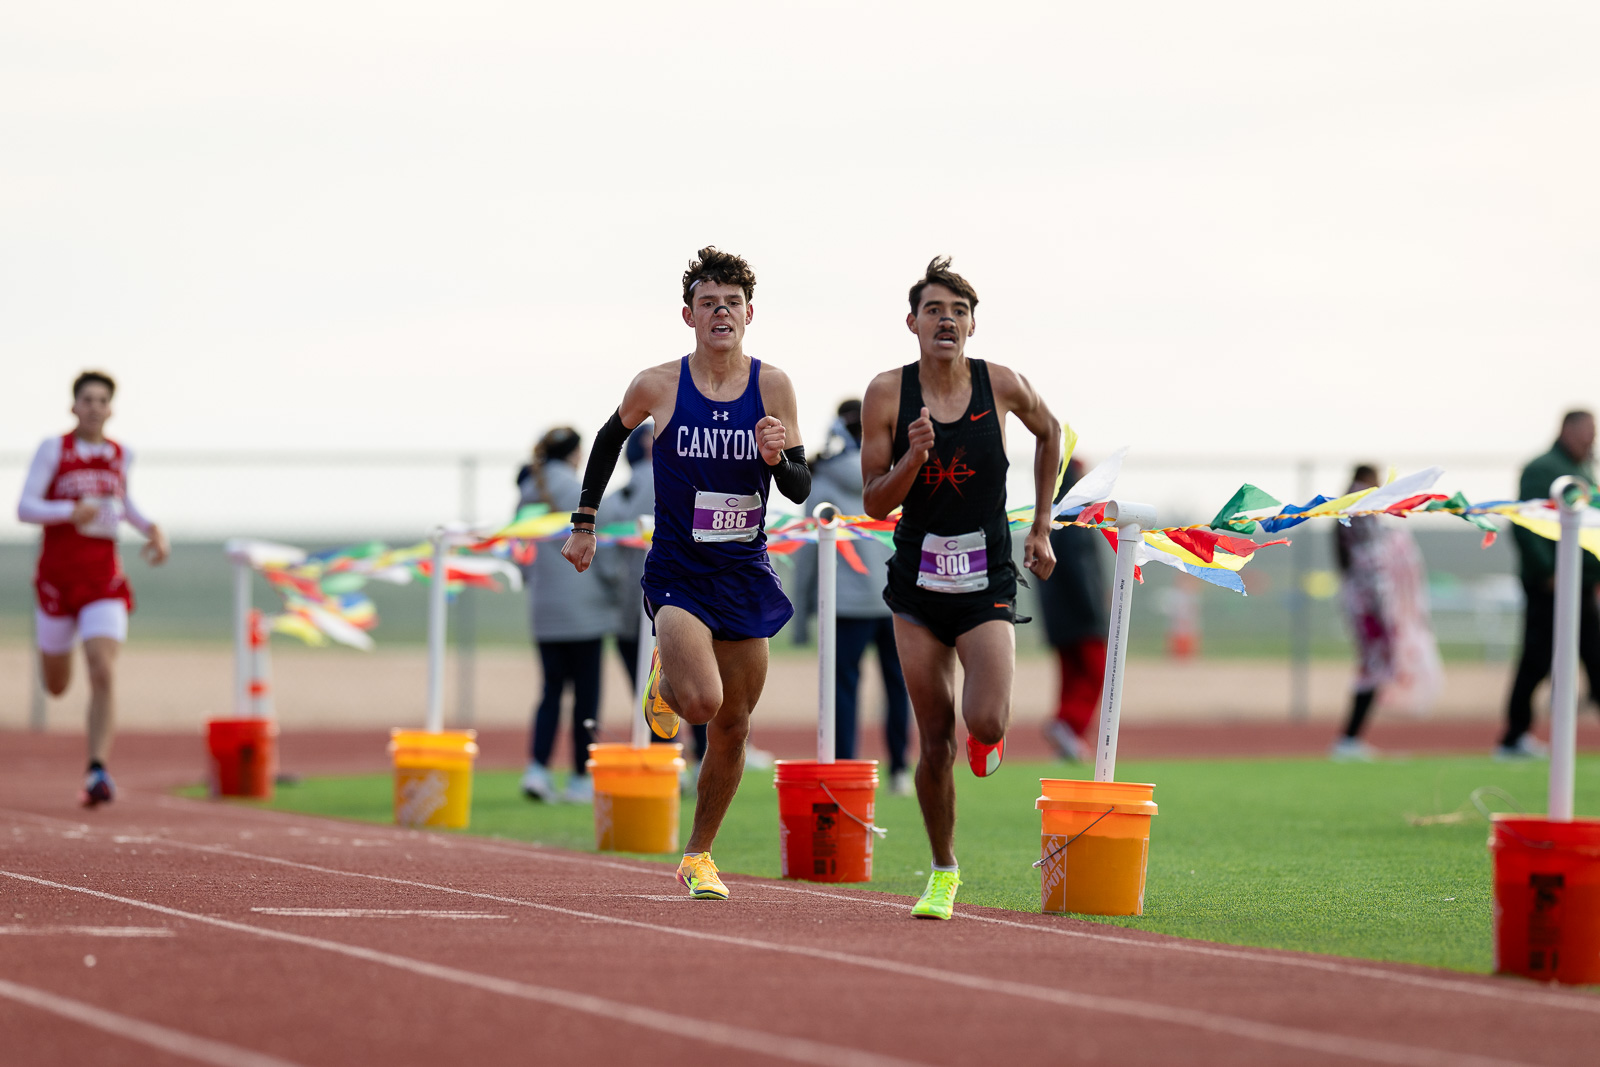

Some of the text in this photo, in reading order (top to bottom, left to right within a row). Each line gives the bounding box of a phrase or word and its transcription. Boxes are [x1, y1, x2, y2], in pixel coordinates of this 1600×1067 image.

[677, 425, 758, 460] CANYON
[712, 510, 748, 530] 886
[936, 553, 970, 575] 900
